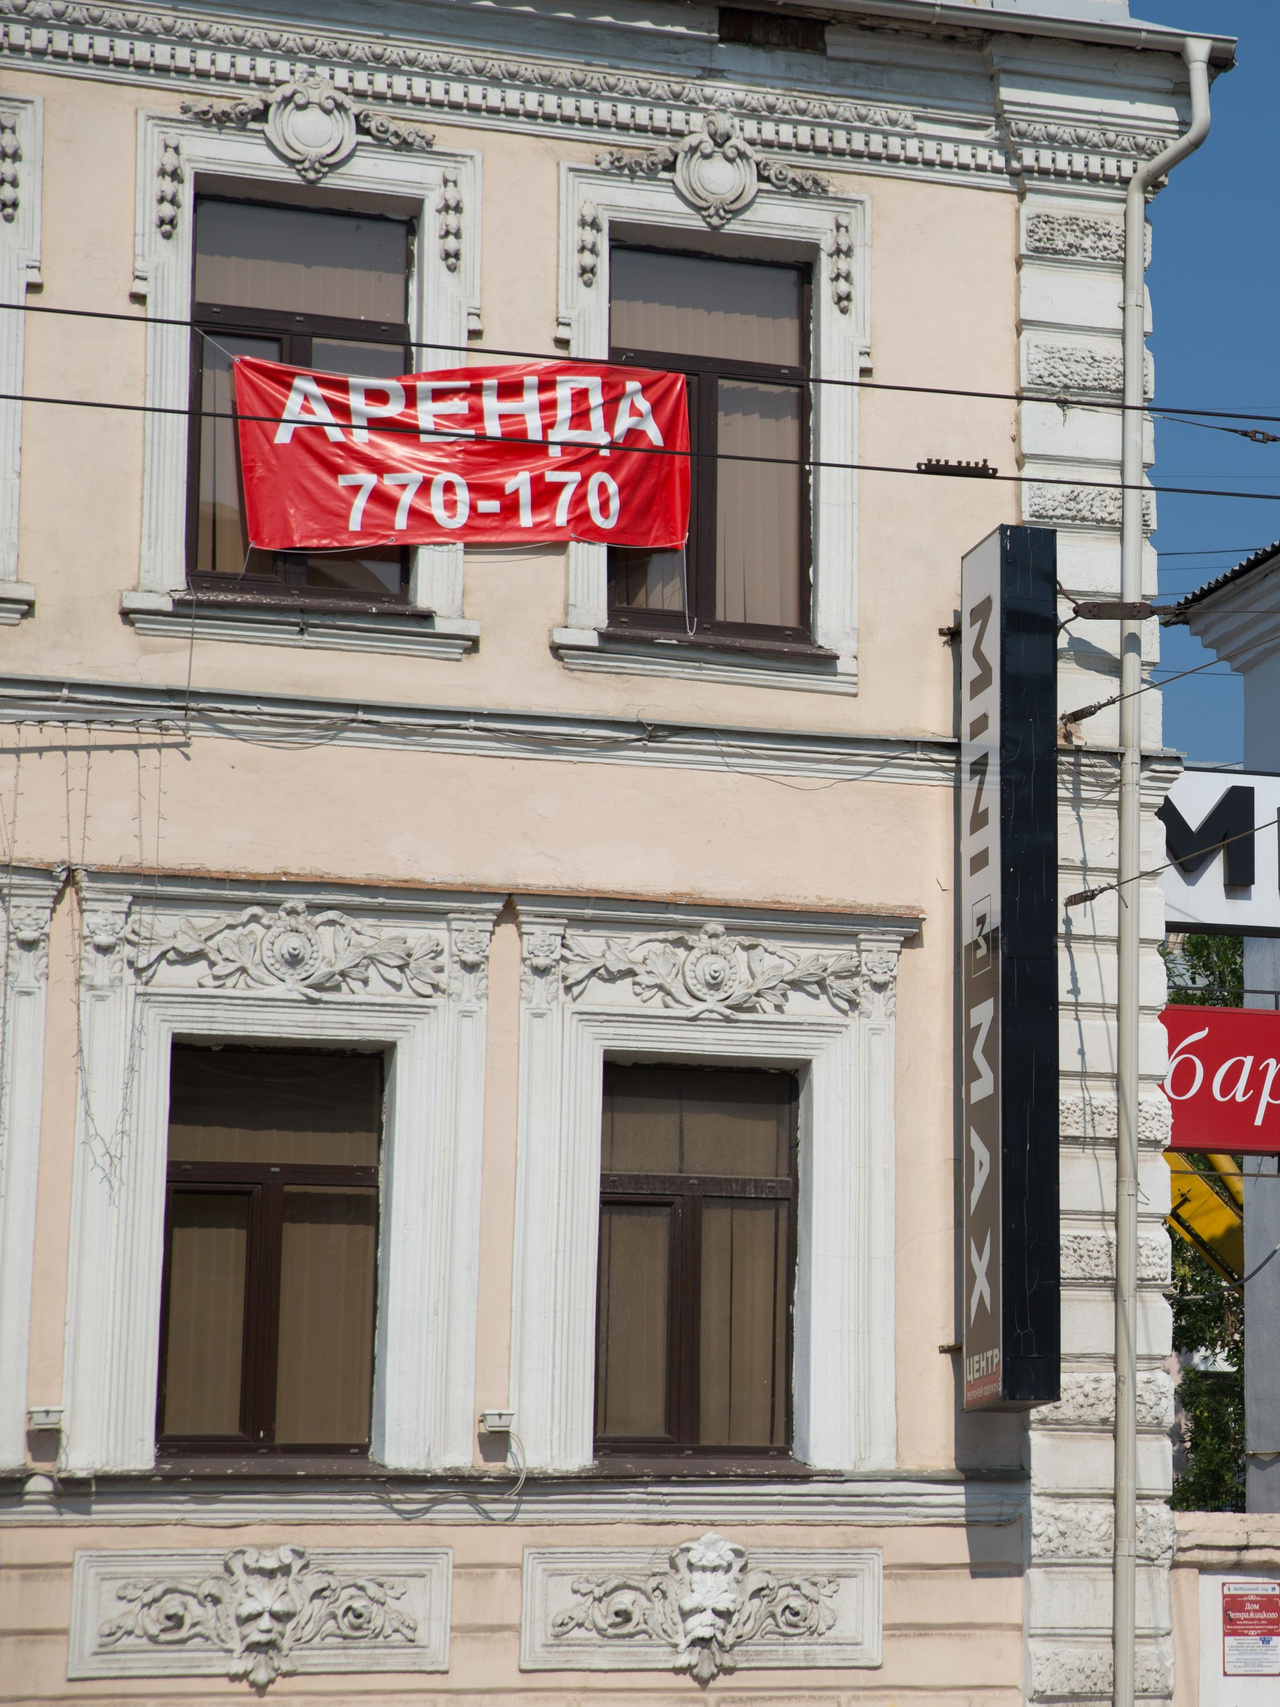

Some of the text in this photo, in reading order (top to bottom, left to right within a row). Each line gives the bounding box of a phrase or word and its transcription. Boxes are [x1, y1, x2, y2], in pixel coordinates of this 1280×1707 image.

[273, 374, 665, 457] АРЕНДА
[337, 470, 621, 532] 770-170
[969, 595, 994, 877] MINI
[969, 997, 995, 1329] MAX
[966, 1347, 1001, 1386] ЦЕНТР
[1244, 1602, 1260, 1611] Дом
